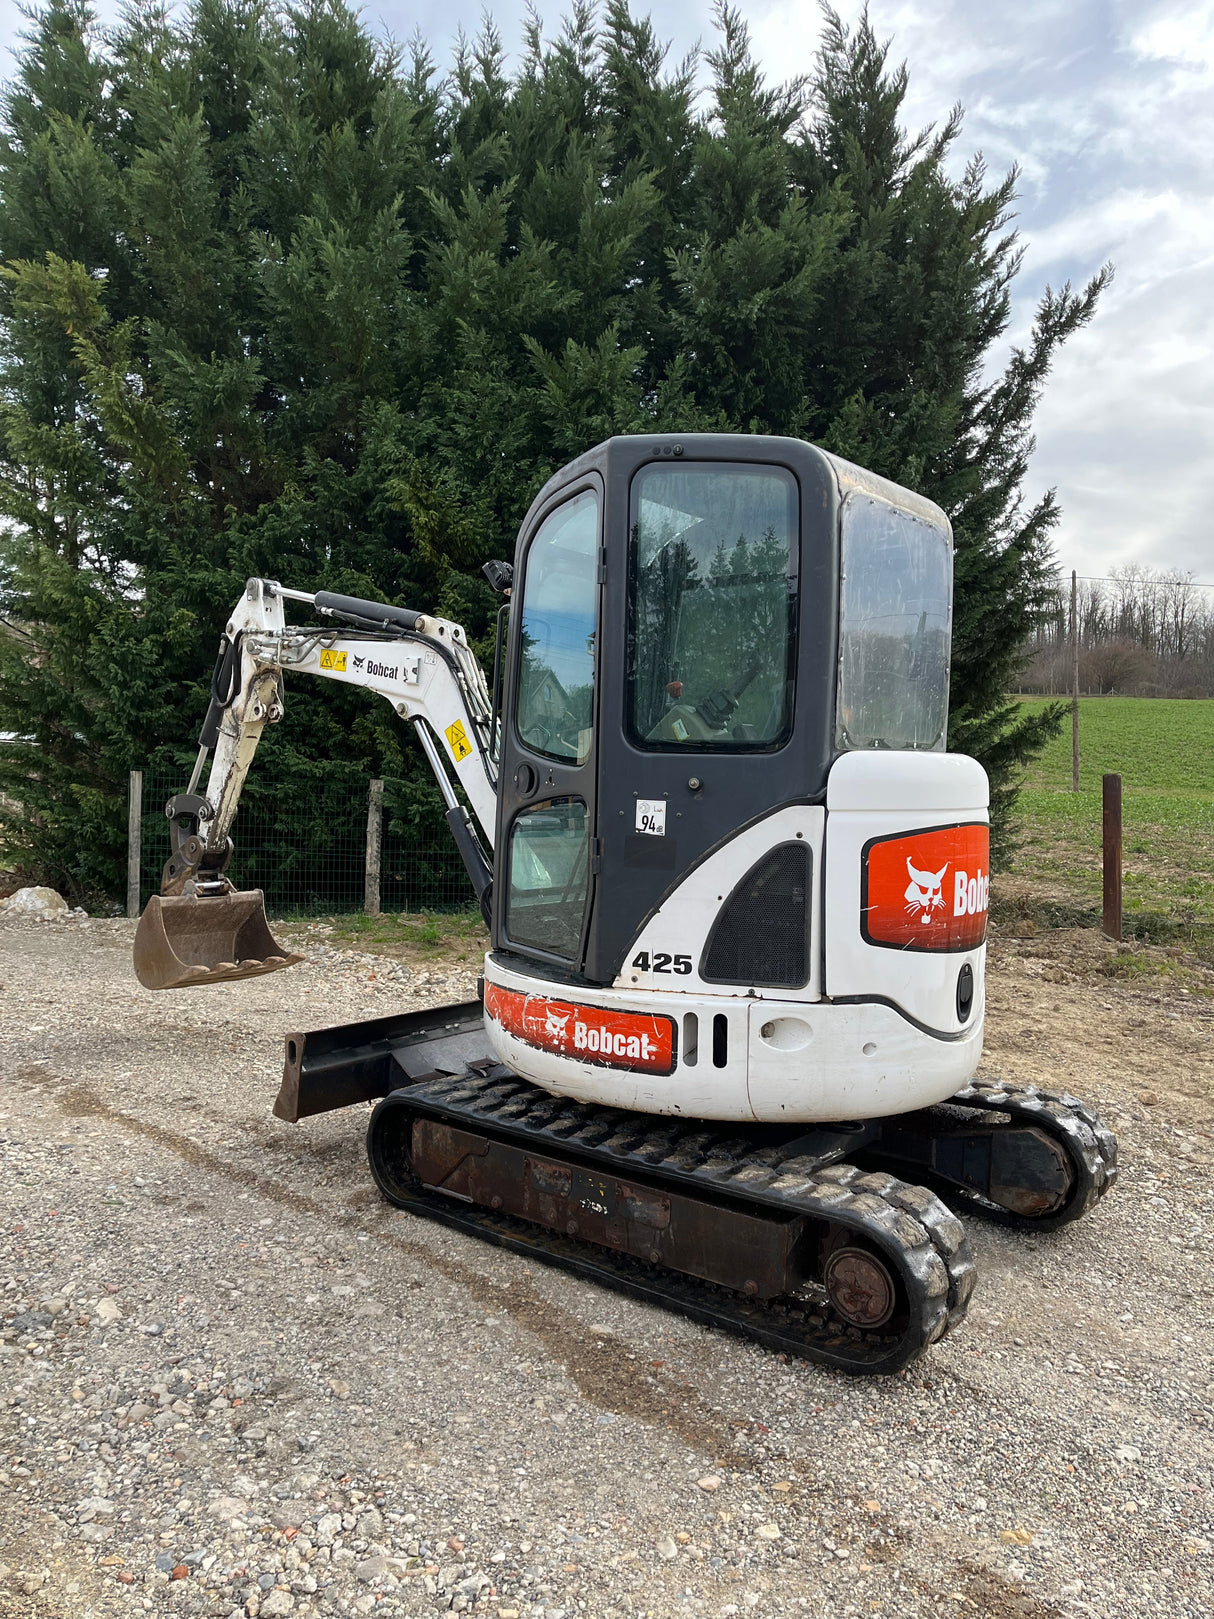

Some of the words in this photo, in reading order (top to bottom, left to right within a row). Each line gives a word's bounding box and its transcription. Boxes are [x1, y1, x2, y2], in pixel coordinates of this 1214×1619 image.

[367, 660, 398, 681] Bobcat
[642, 815, 656, 832] 94
[953, 869, 989, 917] Bobc
[632, 952, 692, 975] 425
[575, 1021, 649, 1060] Bobcat
